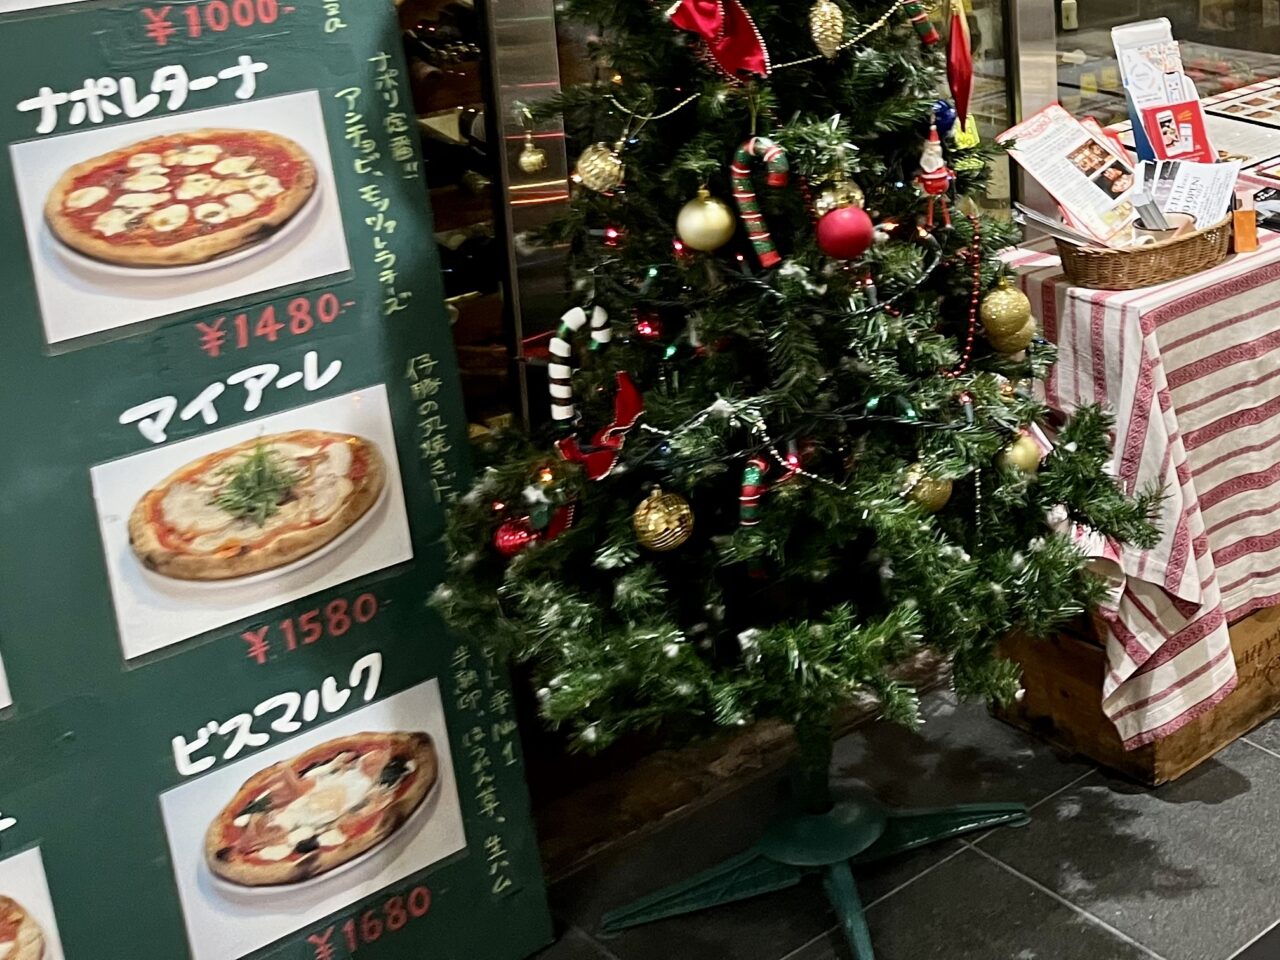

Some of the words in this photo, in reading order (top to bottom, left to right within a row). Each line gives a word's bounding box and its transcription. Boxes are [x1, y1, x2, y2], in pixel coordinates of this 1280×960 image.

[17, 55, 268, 135] ナポレターナ
[118, 351, 342, 444] マイアーレ
[172, 651, 383, 776] ビスマルク
